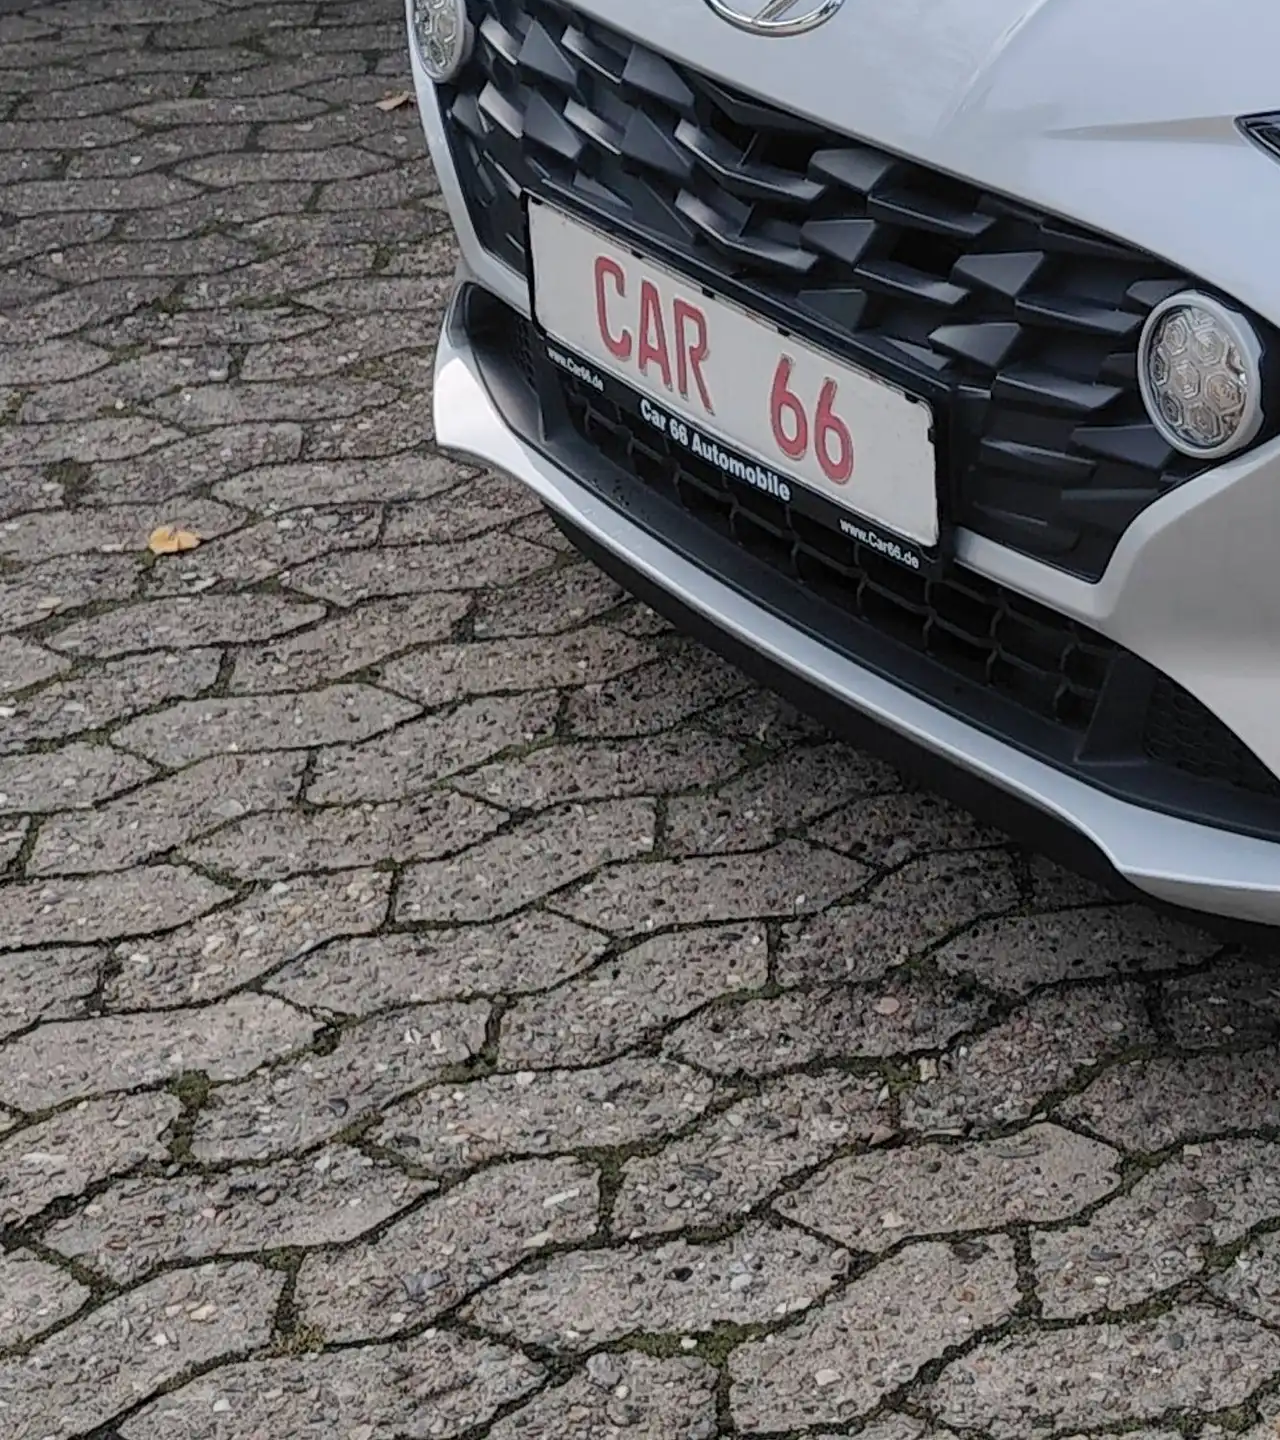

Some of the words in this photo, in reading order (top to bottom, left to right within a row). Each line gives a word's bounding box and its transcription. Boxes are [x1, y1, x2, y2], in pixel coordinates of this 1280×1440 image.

[594, 255, 716, 417] CAR
[769, 353, 854, 486] 66
[640, 399, 667, 432] Car
[691, 432, 791, 502] Automobile
[839, 519, 920, 570] www.Car66.de
